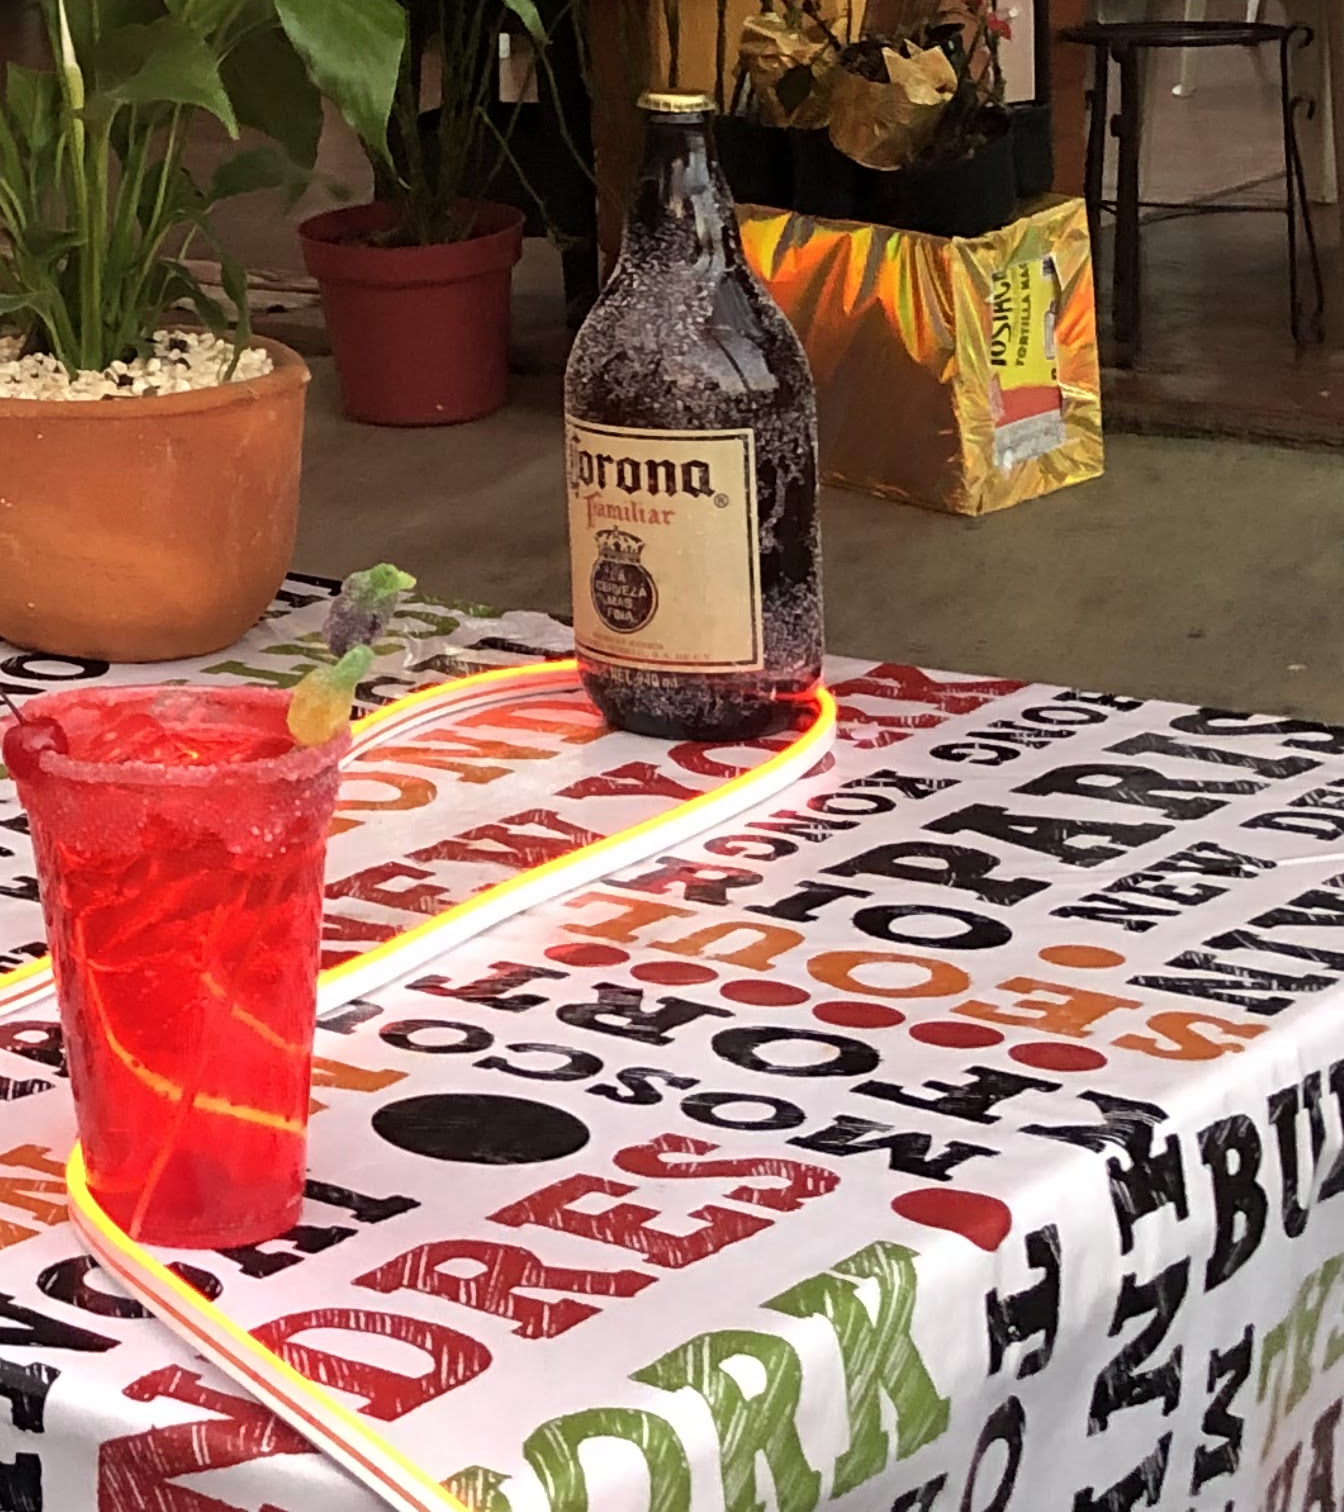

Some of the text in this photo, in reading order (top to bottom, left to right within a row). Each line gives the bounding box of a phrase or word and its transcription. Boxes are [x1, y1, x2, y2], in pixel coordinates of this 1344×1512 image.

[582, 489, 676, 528] Familiar
[703, 768, 962, 862] KONG
[819, 706, 1344, 905] PARIS
[599, 854, 1015, 952] RIO
[1048, 839, 1278, 933] NEW
[555, 890, 1272, 1064] SEOUL
